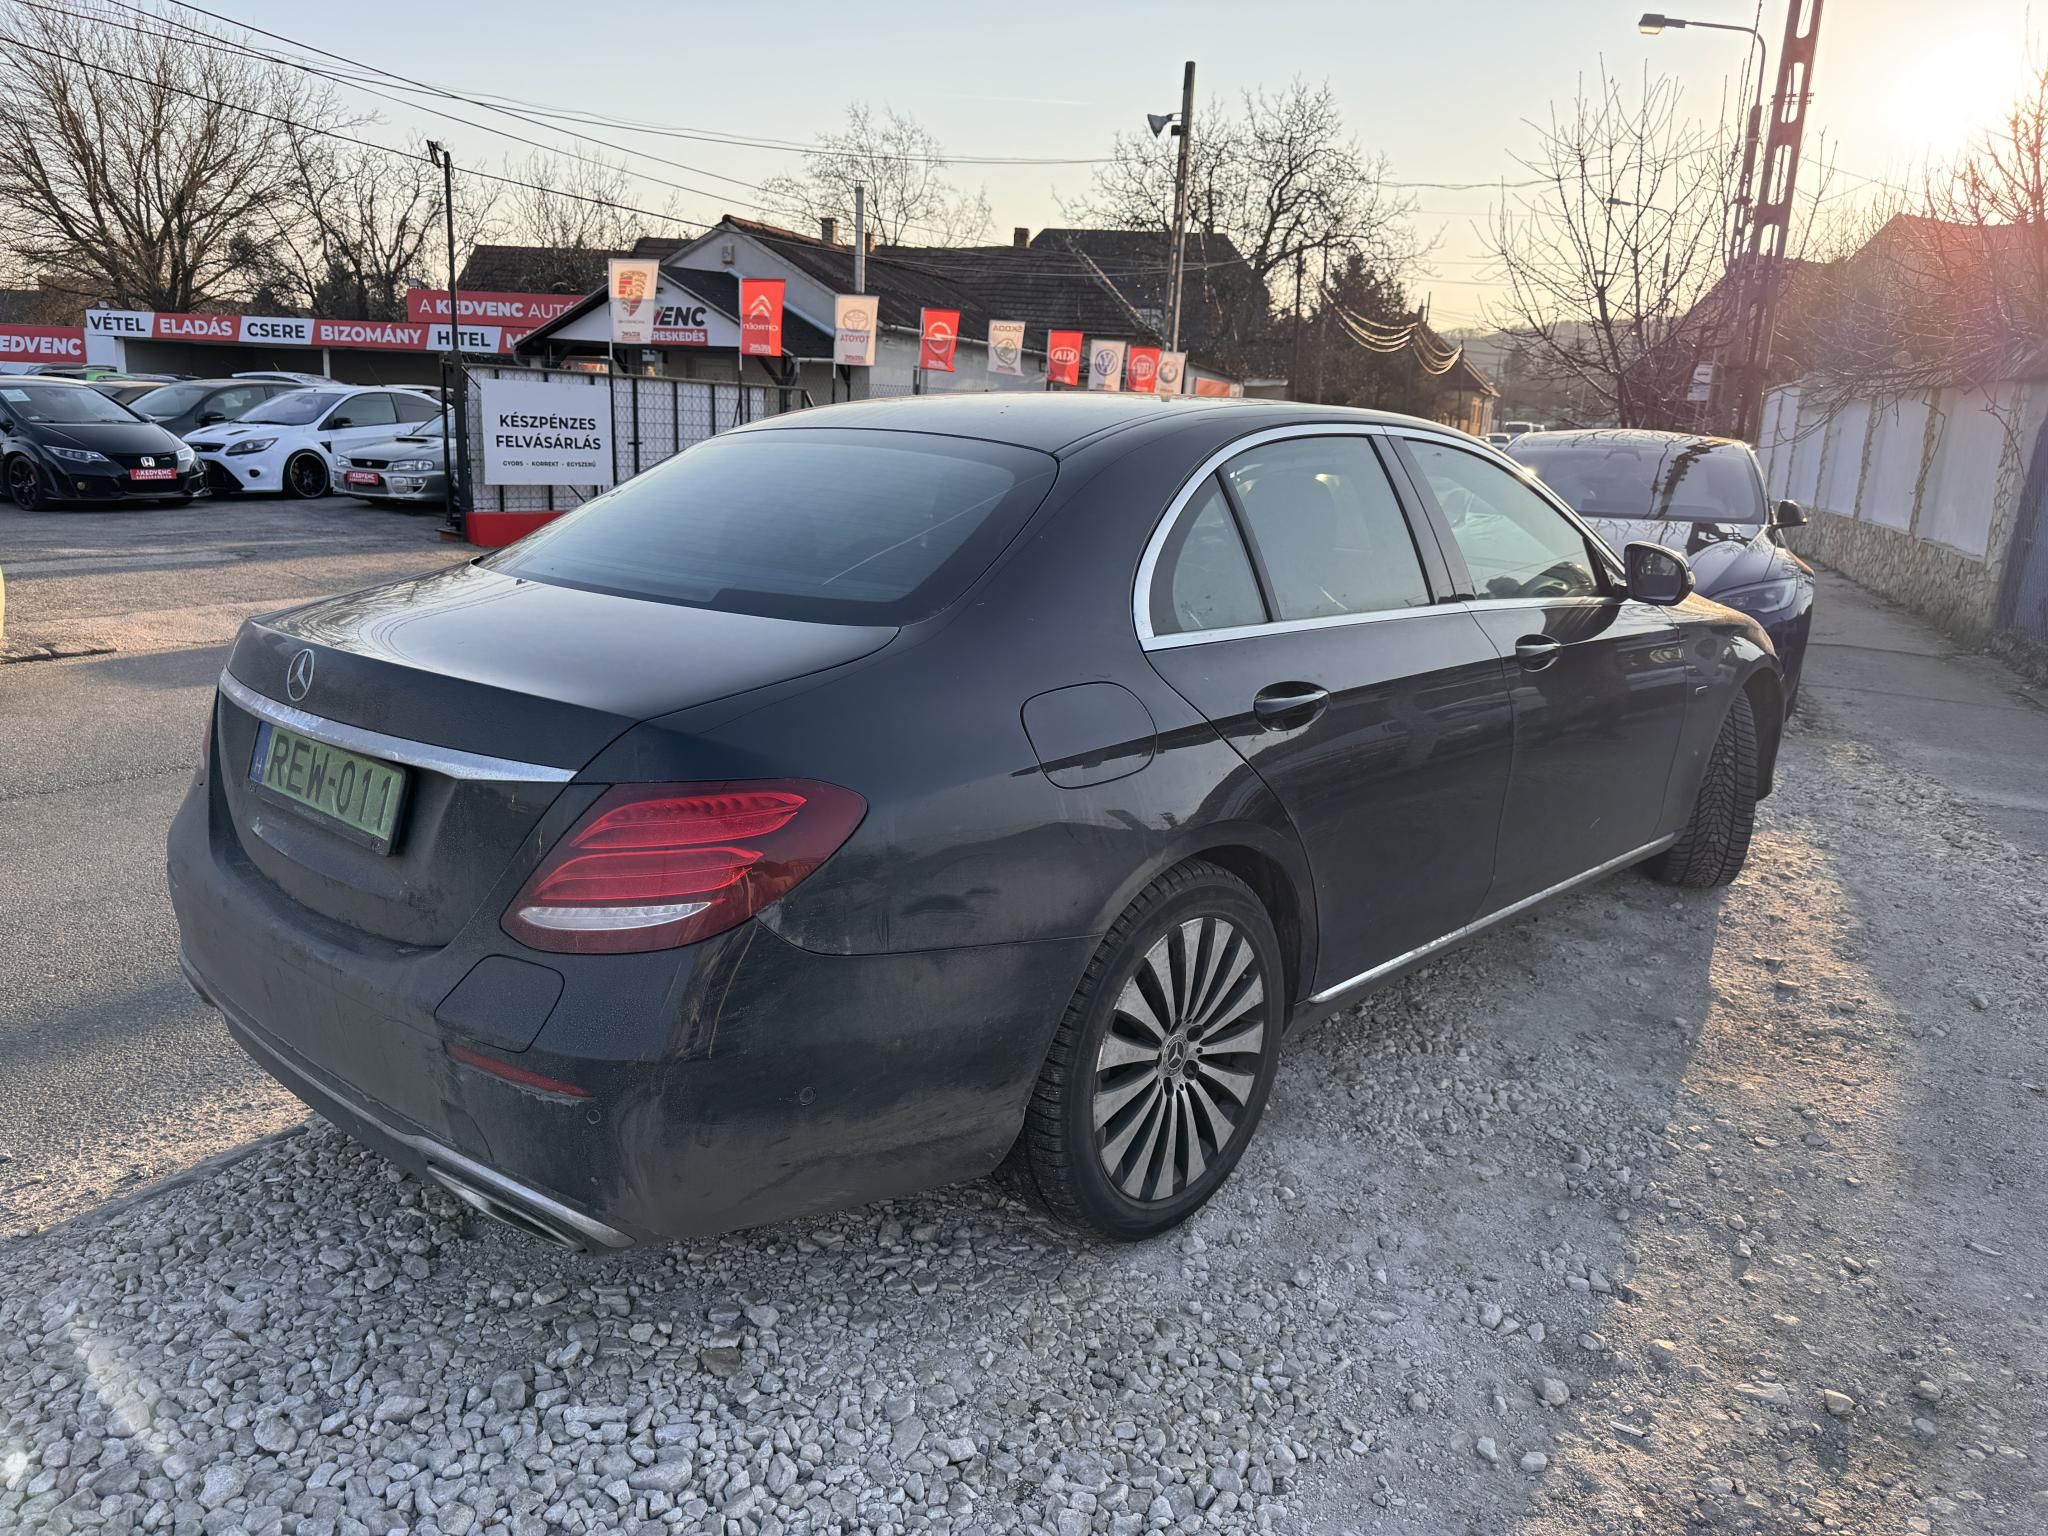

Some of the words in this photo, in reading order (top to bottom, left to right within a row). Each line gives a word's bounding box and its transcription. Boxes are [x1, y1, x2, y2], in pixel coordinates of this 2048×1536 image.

[419, 299, 432, 313] A
[89, 313, 145, 332] VÉTEL
[160, 316, 232, 337] ELADÁS
[247, 322, 305, 339] CSERE
[320, 324, 422, 345] BIZOMÁNY
[437, 330, 491, 347] HTEL
[499, 412, 596, 430] KÉSZPÉNZES
[496, 433, 601, 450] FELVÁSÁRLÁS
[267, 735, 393, 831] REW-011
